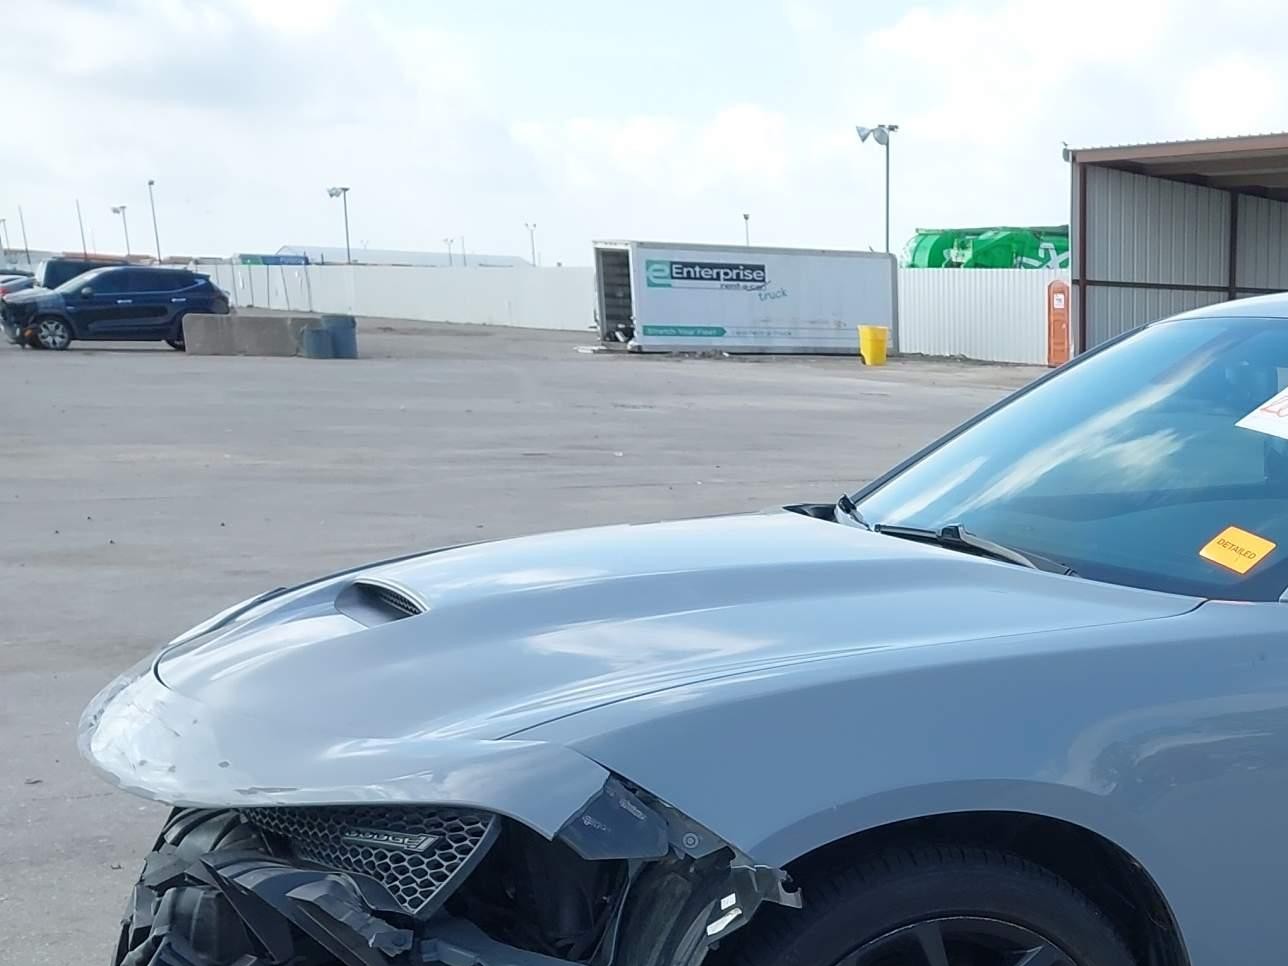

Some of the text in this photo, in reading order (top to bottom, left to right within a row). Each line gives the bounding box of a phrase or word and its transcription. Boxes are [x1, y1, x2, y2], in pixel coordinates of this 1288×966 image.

[671, 264, 765, 282] Enterprise
[757, 287, 789, 302] truck
[1216, 538, 1257, 560] DETAILED
